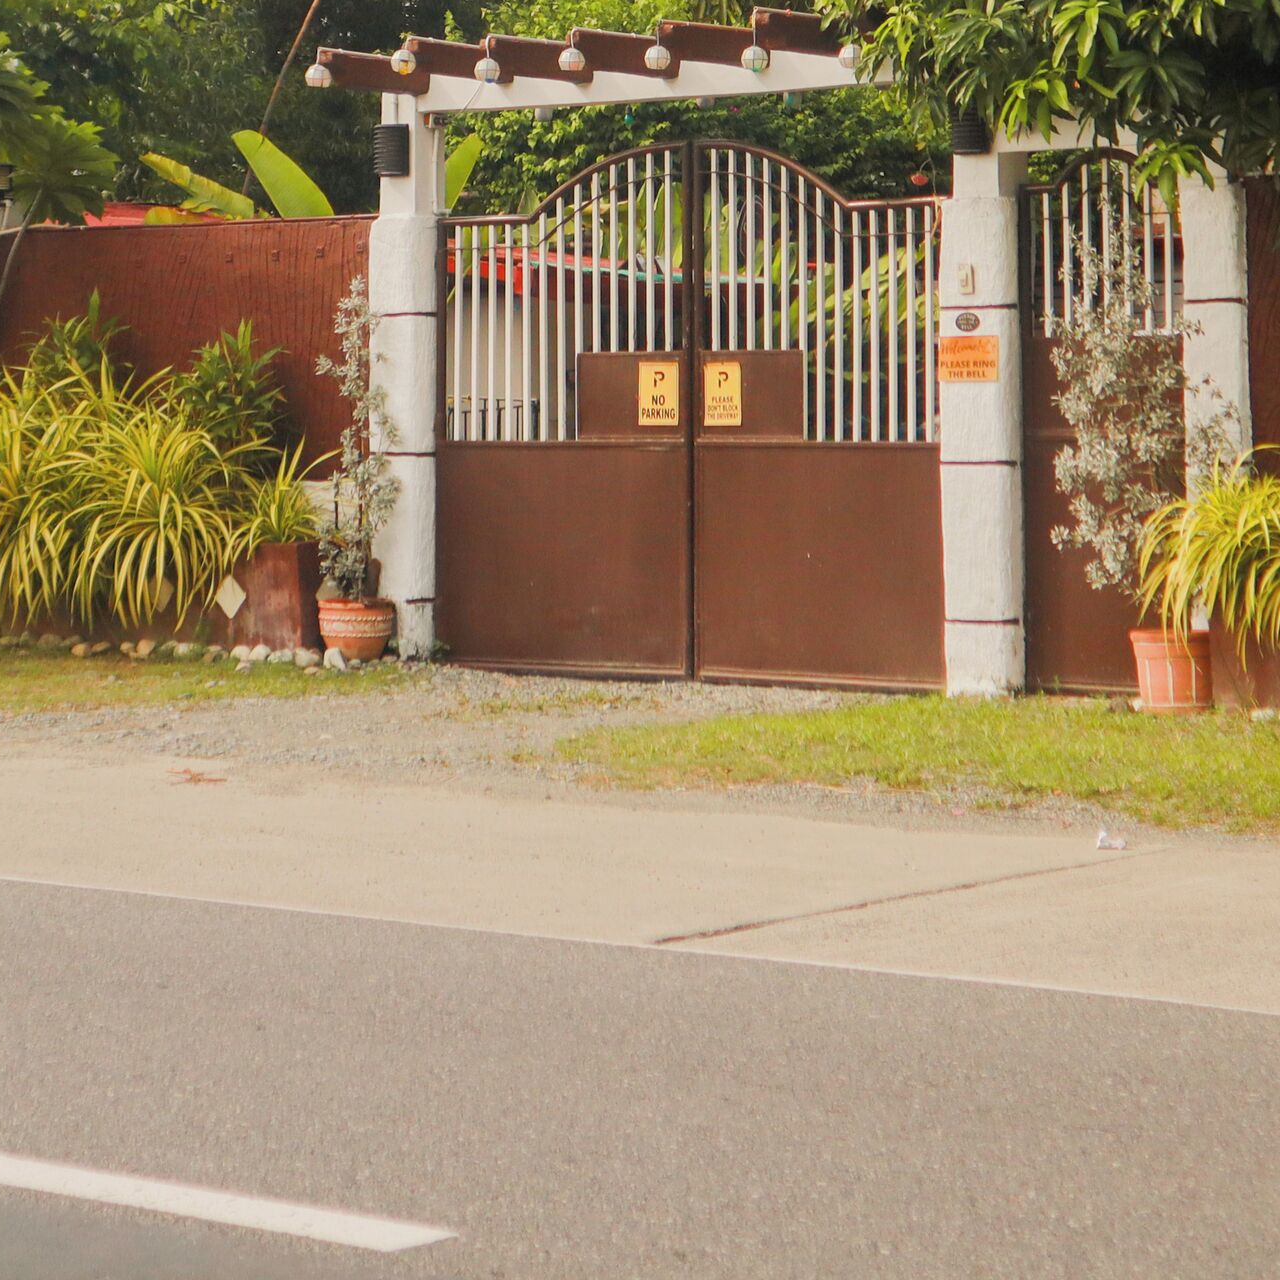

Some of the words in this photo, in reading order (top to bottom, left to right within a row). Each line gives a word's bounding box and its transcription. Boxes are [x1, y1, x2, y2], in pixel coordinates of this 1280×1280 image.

[940, 360, 971, 369] PLEASE
[972, 360, 996, 369] RING
[948, 370, 964, 379] THE
[966, 370, 987, 379] BELL
[651, 394, 666, 406] NO
[711, 396, 734, 405] PLEASE
[641, 408, 676, 420] PARKING
